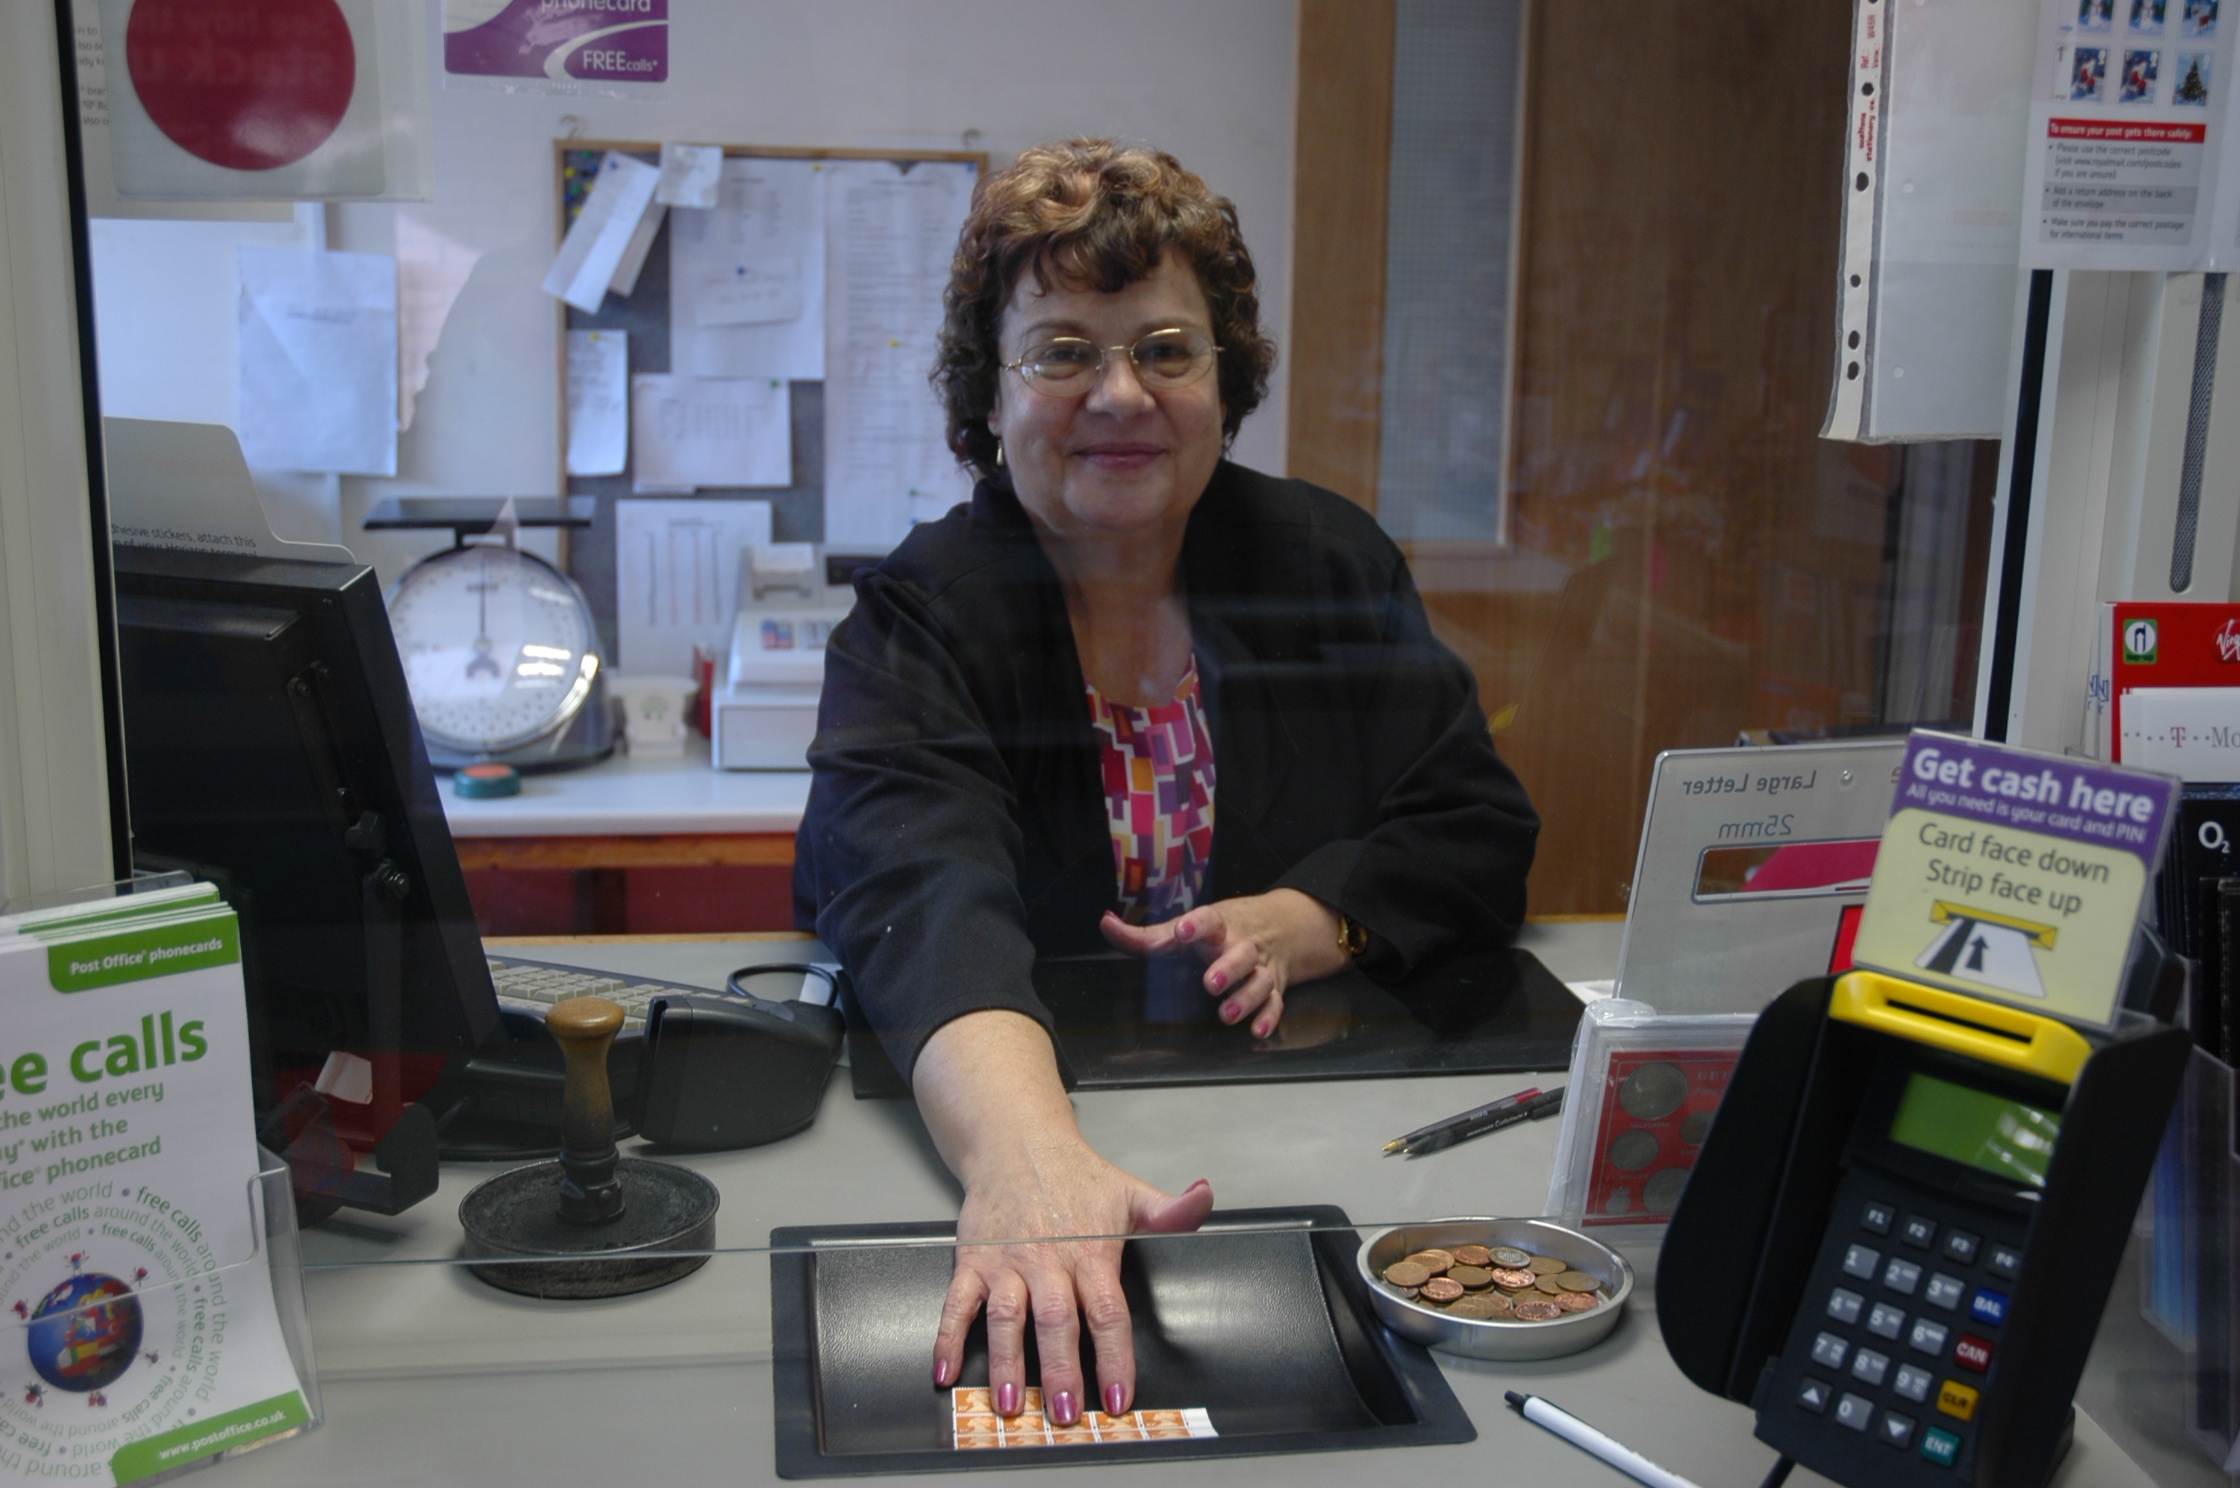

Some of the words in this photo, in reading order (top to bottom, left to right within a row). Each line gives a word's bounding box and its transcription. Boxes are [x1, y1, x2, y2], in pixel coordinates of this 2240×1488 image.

[2061, 125, 2085, 134] ensure
[2086, 126, 2104, 137] your
[2105, 127, 2122, 137] post
[2124, 127, 2142, 138] gets
[2143, 127, 2165, 138] there
[2057, 143, 2080, 153] Please
[2081, 146, 2094, 154] use
[2095, 145, 2108, 154] the
[2109, 146, 2135, 155] correct
[2137, 147, 2171, 158] postcode
[2061, 170, 2074, 179] you
[2075, 171, 2087, 179] are
[2053, 186, 2066, 196] Add
[2075, 188, 2096, 197] return
[2098, 188, 2126, 197] address
[2128, 190, 2138, 198] on
[2140, 189, 2154, 198] the
[2155, 189, 2172, 198] back
[2052, 199, 2060, 208] of
[2060, 200, 2072, 208] the
[2074, 200, 2104, 209] envelope
[2050, 230, 2060, 238] for
[2061, 231, 2101, 240] international
[2103, 231, 2124, 240] items
[2051, 217, 2068, 226] Make
[2070, 219, 2085, 227] sure
[2086, 220, 2098, 229] you
[2100, 220, 2113, 230] pay
[2114, 219, 2127, 228] the
[2128, 220, 2153, 229] correct
[2155, 221, 2184, 231] postage
[151, 528, 196, 543] stickers,
[197, 533, 233, 546] attach
[233, 536, 257, 549] this
[1913, 748, 1976, 789] Get
[1981, 768, 2062, 806] cash
[2068, 775, 2155, 823] here
[1906, 783, 1928, 799] All
[1928, 789, 1957, 808] you
[1957, 792, 1995, 816] need
[1996, 801, 2010, 816] is
[2010, 805, 2047, 824] your
[2047, 810, 2082, 831] card
[2083, 818, 2115, 839] and
[1919, 823, 1976, 855] Card
[1980, 834, 2033, 867] face
[2038, 849, 2110, 883] down
[1926, 859, 1983, 895] Strip
[1990, 872, 2042, 906] face
[2049, 891, 2082, 917] up
[70, 959, 101, 977] Post
[149, 937, 223, 964] phonecards
[69, 1010, 209, 1084] calls
[38, 1090, 100, 1122] world
[105, 1081, 165, 1103] every
[30, 1126, 83, 1153] with
[89, 1118, 129, 1141] the
[47, 1135, 162, 1185] phonecard
[60, 1181, 114, 1205] world
[136, 1185, 171, 1214] free
[23, 1197, 56, 1222] the
[53, 1205, 90, 1229] calls
[94, 1206, 151, 1227] around
[1868, 1209, 1885, 1225] F1
[16, 1222, 50, 1249] free
[101, 1222, 129, 1239] free
[150, 1218, 174, 1242] the
[171, 1209, 203, 1243] calls
[1908, 1222, 1926, 1238] F2
[43, 1227, 81, 1253] world
[130, 1231, 157, 1253] calls
[1951, 1237, 1970, 1252] F3
[171, 1239, 200, 1279] world
[1846, 1250, 1858, 1266] 1
[1995, 1252, 2015, 1268] F4
[1886, 1265, 1900, 1281] 2
[1927, 1280, 1943, 1297] 3
[194, 1296, 209, 1331] free
[1829, 1296, 1843, 1312] 4
[1973, 1295, 2002, 1317] BAL
[212, 1312, 229, 1345] the
[1870, 1310, 1884, 1326] 5
[1912, 1325, 1926, 1343] 6
[186, 1335, 204, 1373] calls
[1816, 1338, 1827, 1353] 7
[1956, 1341, 1989, 1365] CAN
[1854, 1354, 1869, 1371] 8
[195, 1350, 222, 1402] world
[1897, 1371, 1911, 1387] 9
[149, 1374, 174, 1401] free
[151, 1374, 193, 1428] around
[1942, 1391, 1969, 1409] CLR
[3, 1398, 38, 1428] world
[121, 1399, 152, 1424] calls
[40, 1424, 65, 1438] the
[68, 1417, 120, 1439] around
[158, 1409, 287, 1462] www.postoffice.co.uk
[18, 1435, 52, 1458] free
[72, 1438, 121, 1460] world
[1924, 1436, 1953, 1455] ENT
[25, 1457, 102, 1479] around
